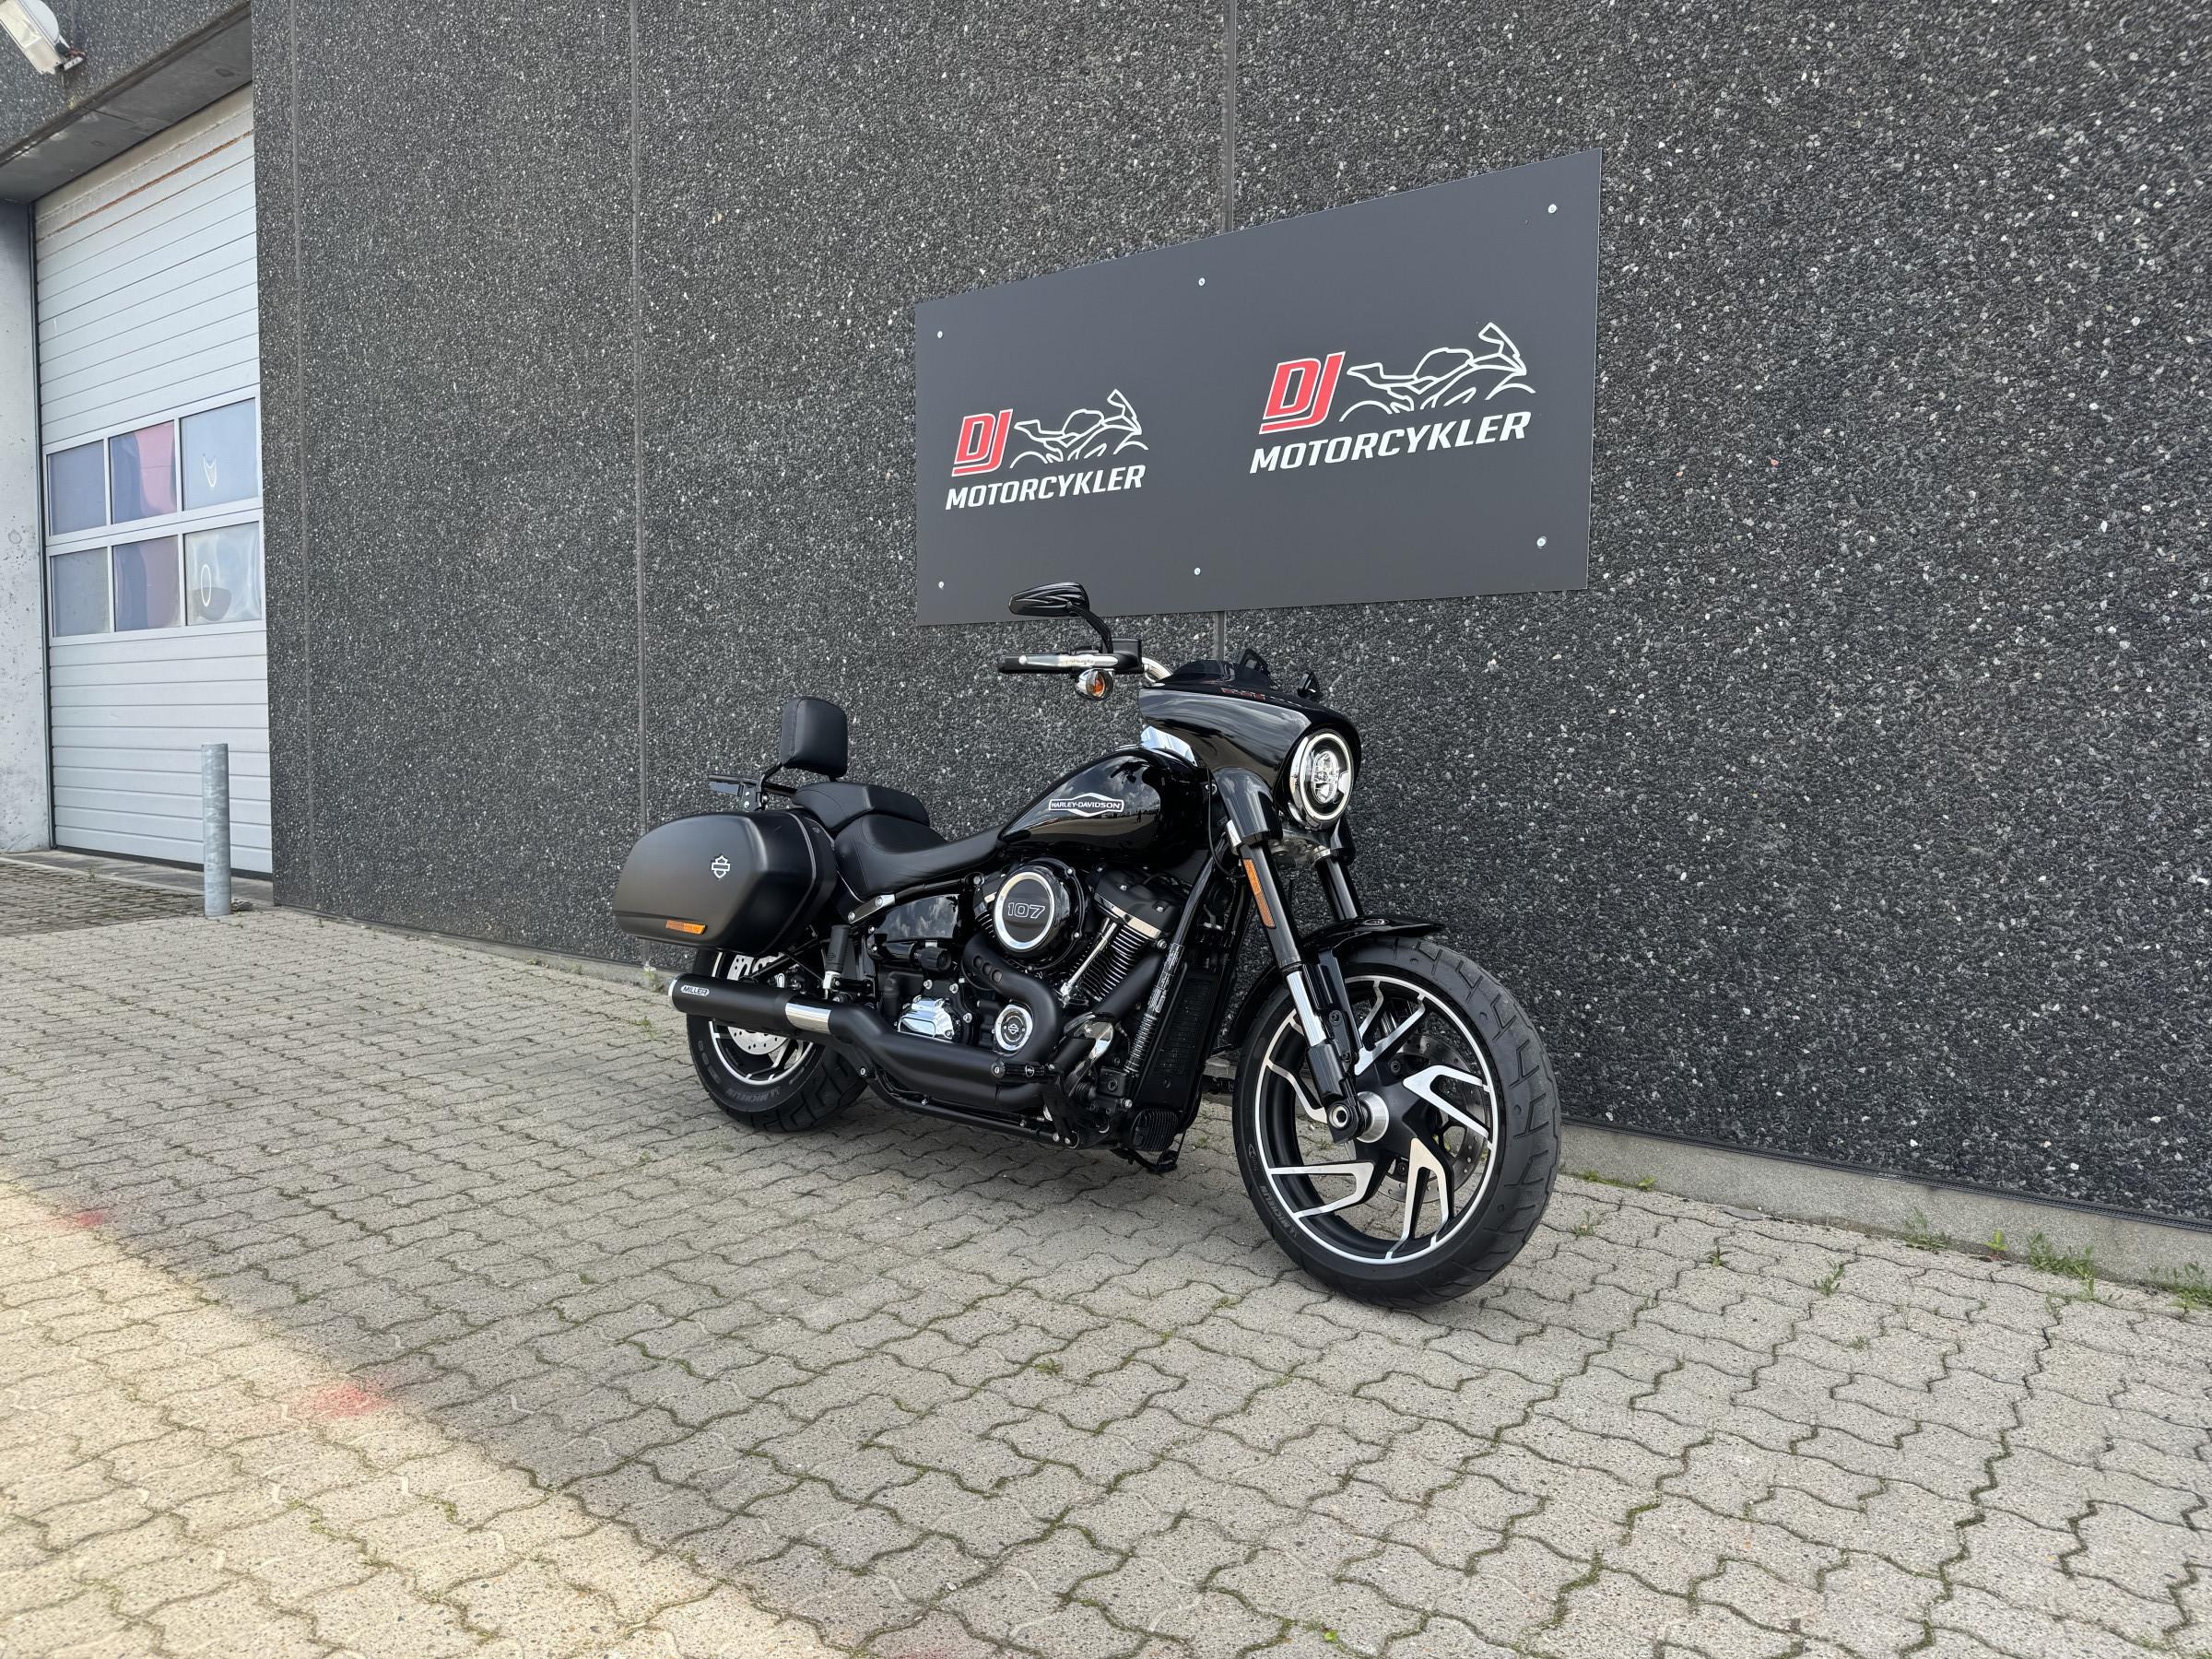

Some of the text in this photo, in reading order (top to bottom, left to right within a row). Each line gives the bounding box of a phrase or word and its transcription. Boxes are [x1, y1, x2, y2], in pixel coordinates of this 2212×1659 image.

[1258, 351, 1346, 435] DJ
[951, 408, 1013, 477] DJ
[1249, 411, 1532, 474] MOTORCYKLER
[945, 465, 1147, 511] MOTORCYKLER
[1051, 801, 1122, 809] HARLEY-DAVIDSON
[1007, 901, 1046, 919] 107
[682, 986, 708, 995] MILLER
[725, 1088, 769, 1103] MICHELIN
[1260, 1185, 1290, 1229] MICHELIN
